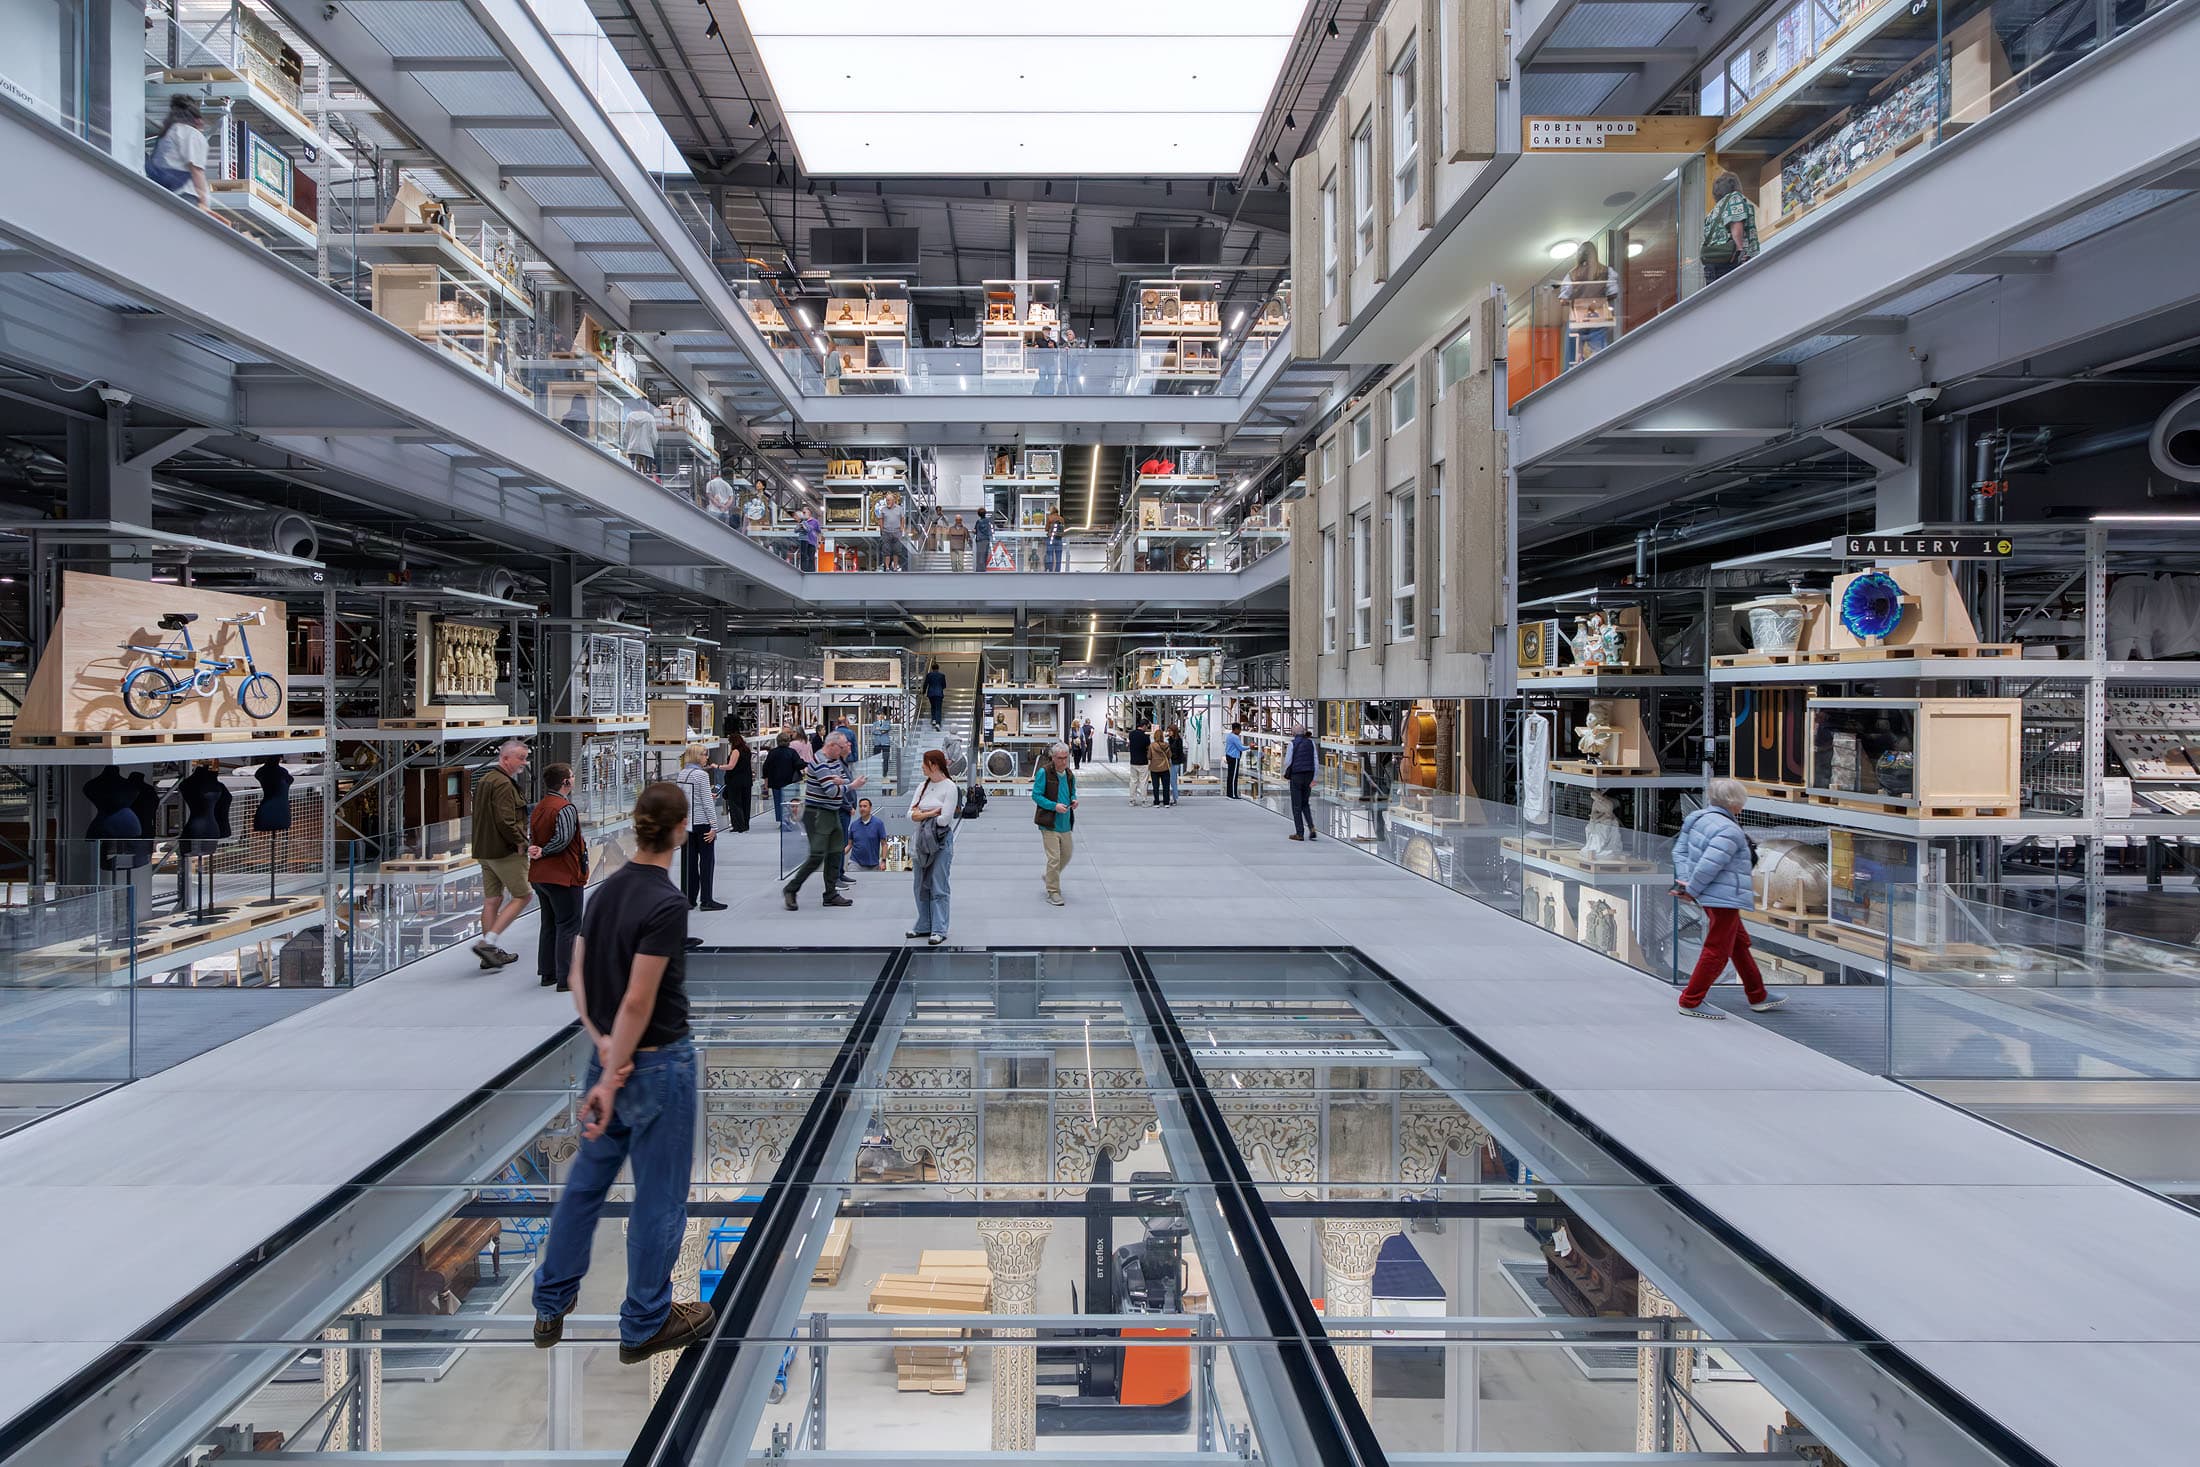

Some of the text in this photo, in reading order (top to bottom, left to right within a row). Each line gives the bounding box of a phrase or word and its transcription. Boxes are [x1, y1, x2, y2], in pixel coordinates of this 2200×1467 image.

[1534, 123, 1634, 132] ROBIN HOOD
[1533, 137, 1603, 145] GARDENS
[1850, 540, 1992, 553] GALLERY 1
[313, 572, 324, 581] 25
[1095, 1238, 1104, 1266] reflex
